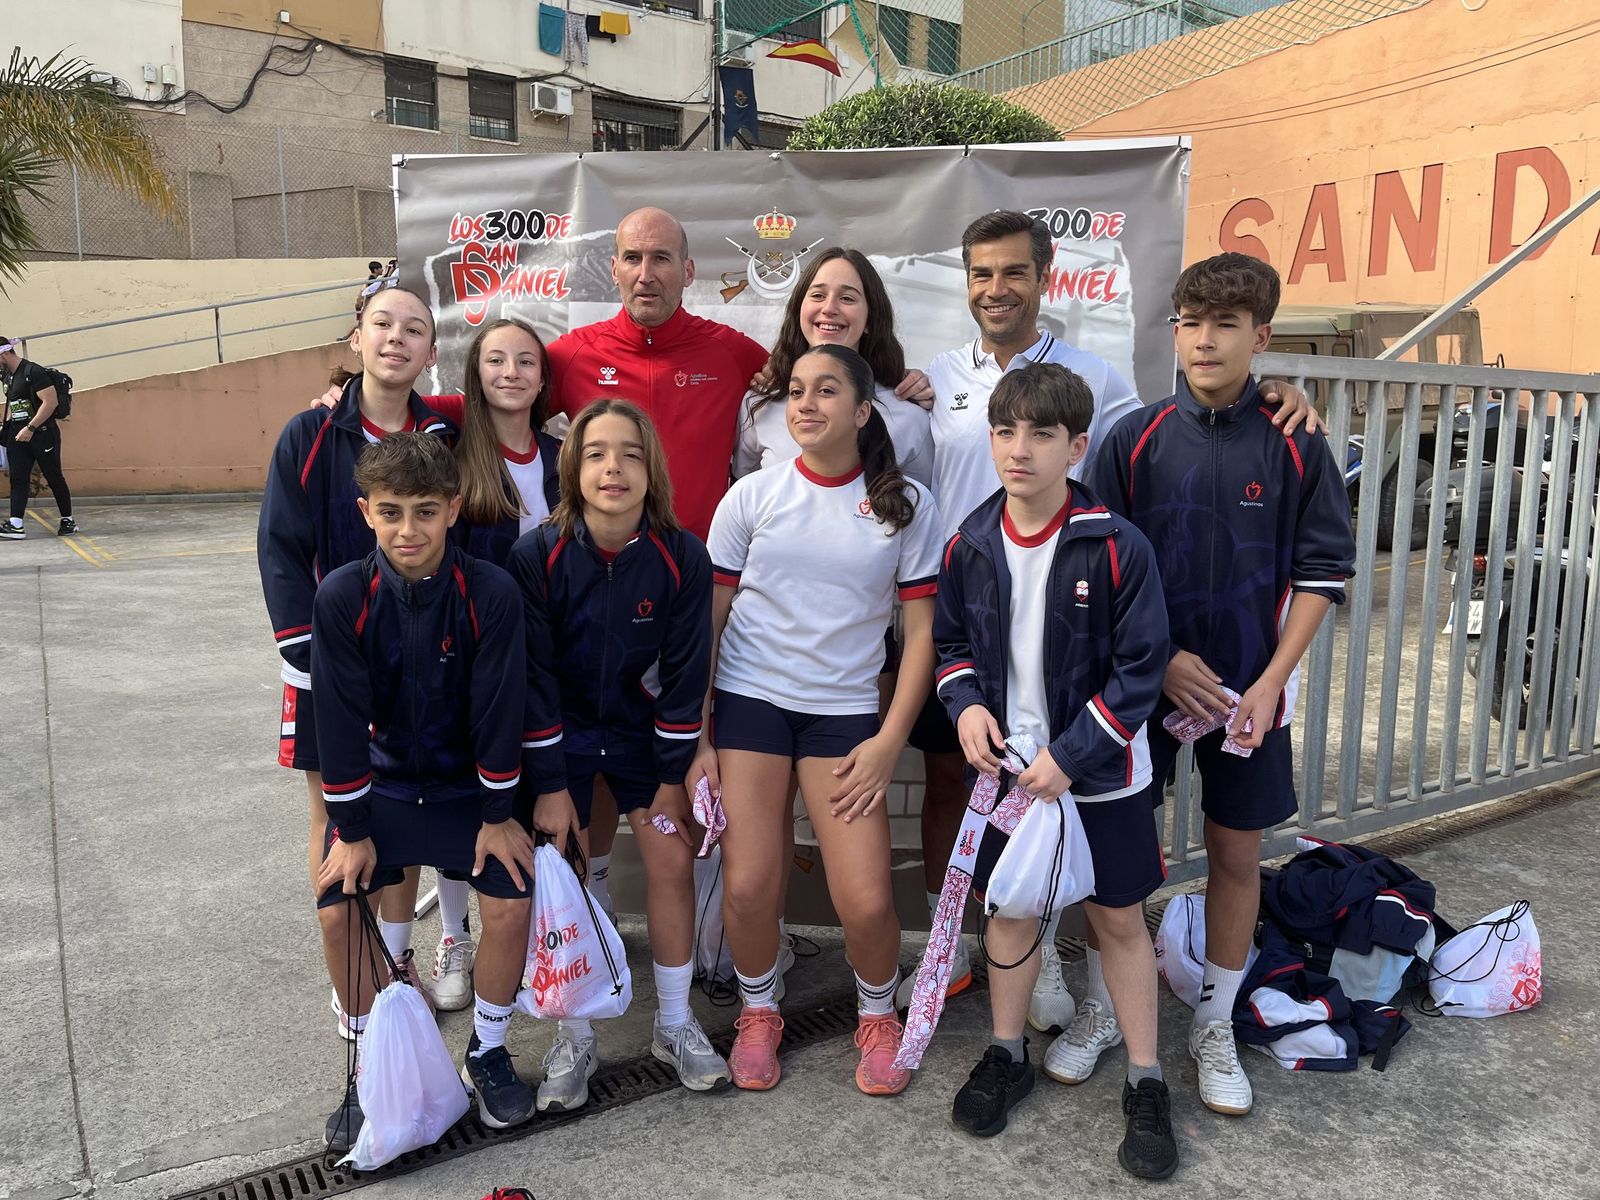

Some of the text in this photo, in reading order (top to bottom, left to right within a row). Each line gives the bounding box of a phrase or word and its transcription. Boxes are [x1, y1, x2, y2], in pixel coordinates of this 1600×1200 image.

[1218, 146, 1600, 285] SAN D
[451, 263, 571, 304] DANIEL
[1047, 264, 1122, 305] ANIEL
[532, 953, 592, 992] DANIEL
